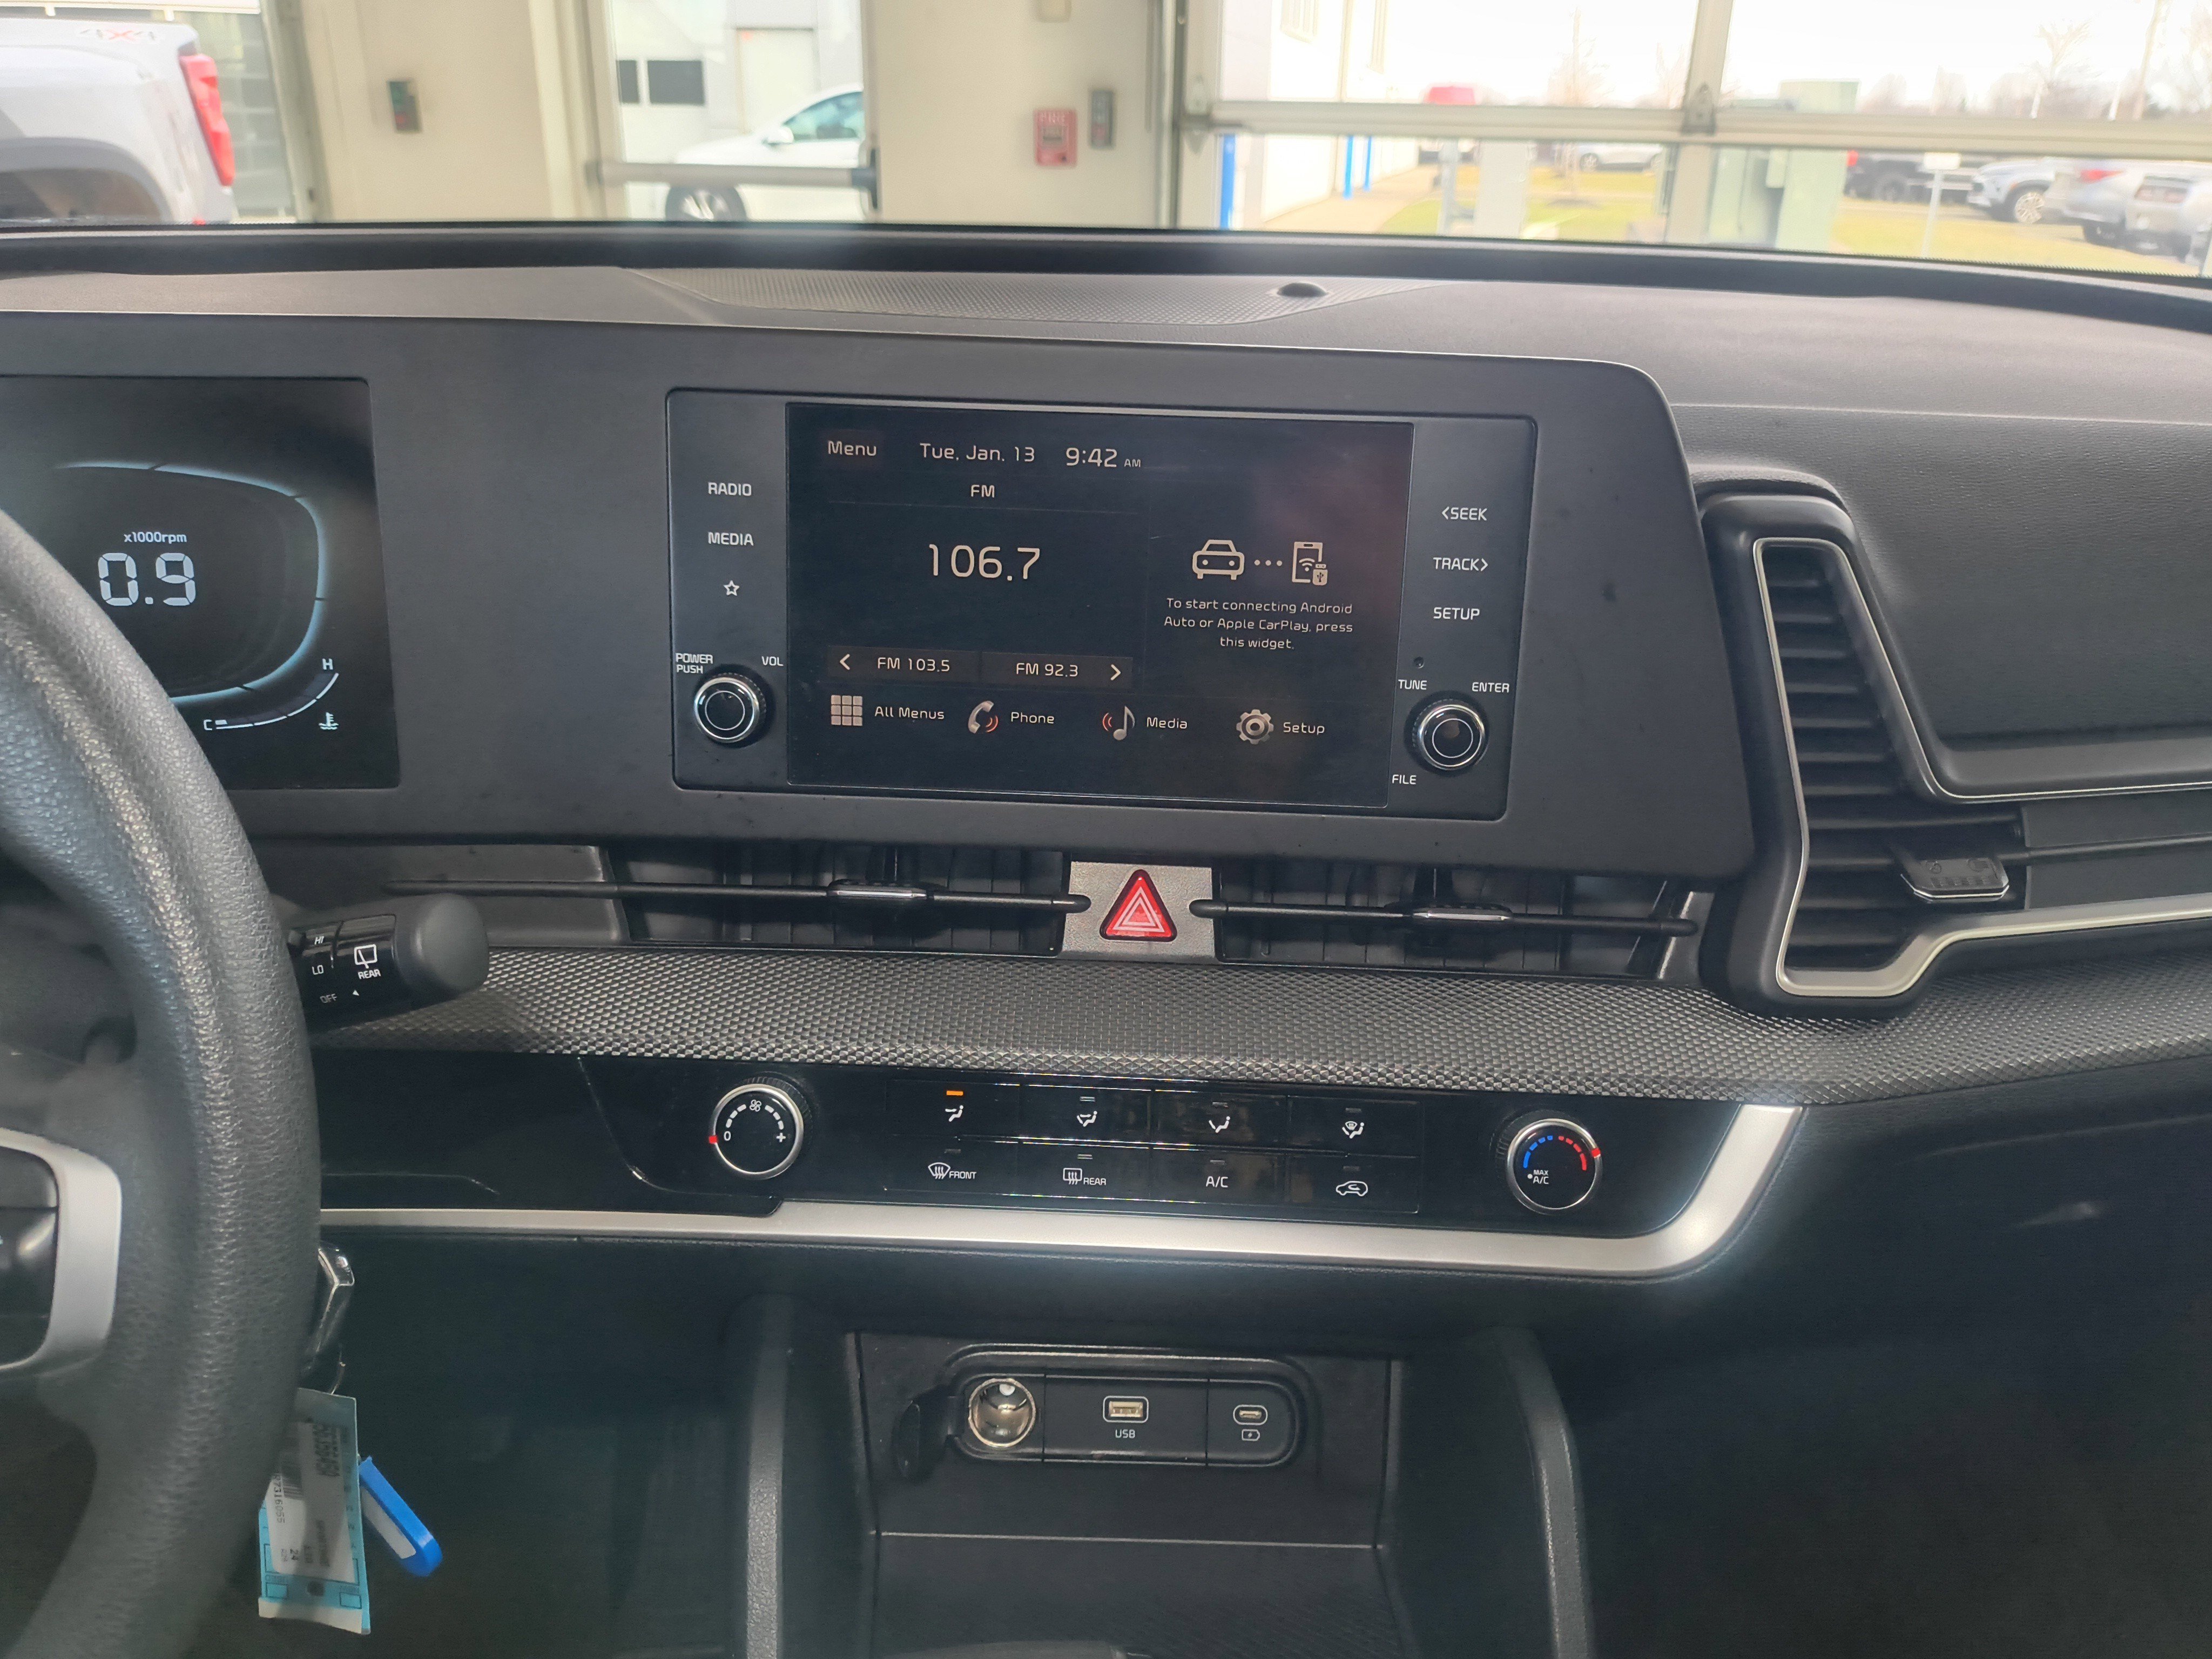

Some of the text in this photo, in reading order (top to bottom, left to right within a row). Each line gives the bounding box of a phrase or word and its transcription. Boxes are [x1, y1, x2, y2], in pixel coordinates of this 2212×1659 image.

[828, 441, 876, 456] Menu
[966, 445, 1005, 462] Jan.
[1015, 446, 1035, 462] 13
[1065, 447, 1141, 468] 9:42 AM
[708, 482, 752, 496] RADIO
[970, 484, 995, 498] FM
[123, 531, 187, 543] x1000rpm
[708, 531, 754, 546] MEDIA
[929, 544, 1040, 581] 106.7
[97, 552, 196, 606] 0.9
[1166, 598, 1352, 614] To start connecting Android
[1433, 606, 1480, 621] SETUP
[1164, 616, 1353, 632] Auto or Apple CarPlay, press
[1220, 637, 1294, 650] this widget.
[322, 658, 333, 670] H
[675, 652, 713, 664] POWER
[761, 656, 784, 666] VOL
[676, 664, 704, 674] PUSH
[878, 657, 950, 672] FM 103.5
[1016, 663, 1078, 677] FM 92.3
[1398, 679, 1427, 690] TUNE
[1472, 682, 1510, 693] ENTER
[874, 706, 945, 719] All Menus
[1011, 712, 1055, 724] Phone
[203, 719, 213, 731] C
[1147, 717, 1188, 729] Media
[1283, 721, 1325, 735] Setup
[1392, 774, 1417, 785] FILE
[314, 935, 325, 945] HI
[312, 965, 324, 975] LO
[358, 969, 381, 979] REAR
[320, 993, 337, 1003] OFF
[948, 1170, 977, 1179] FRONT
[1533, 1176, 1549, 1184] A/C
[1083, 1177, 1107, 1186] REAR
[1205, 1176, 1229, 1188] A/C
[1115, 1429, 1136, 1439] USB
